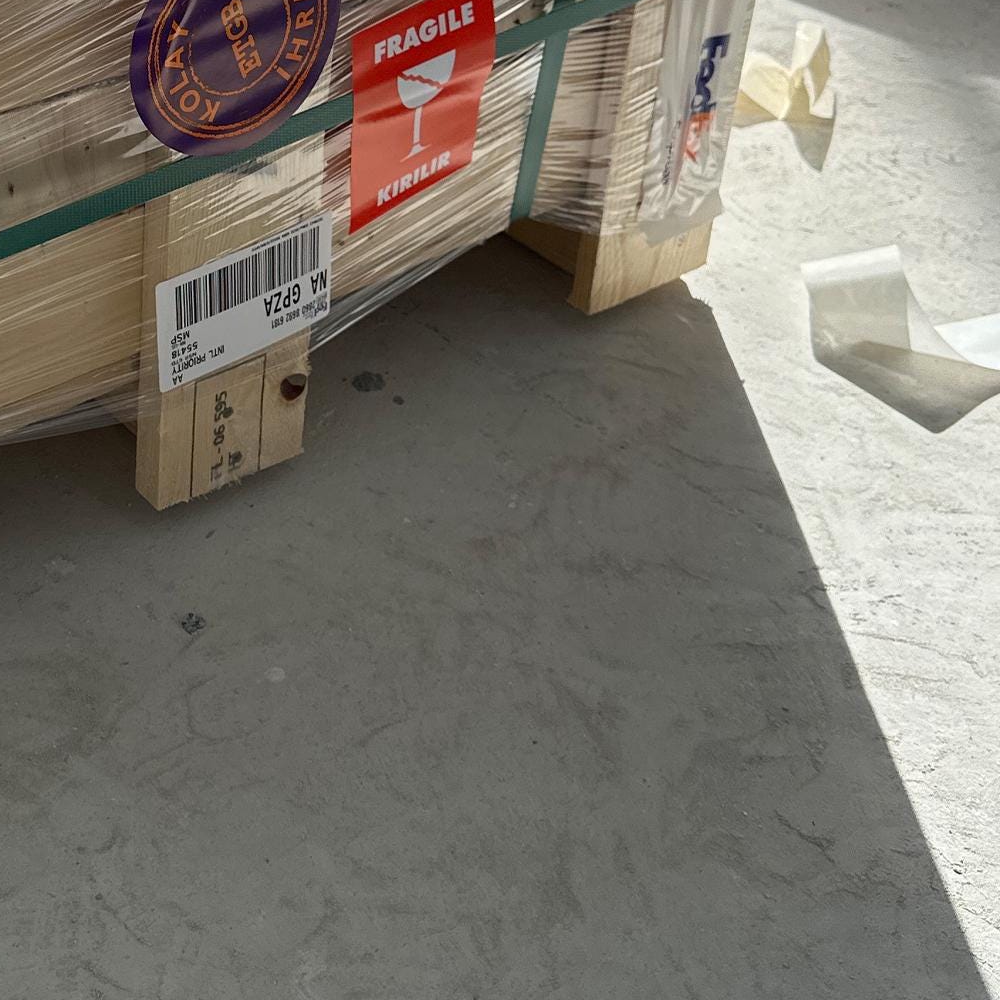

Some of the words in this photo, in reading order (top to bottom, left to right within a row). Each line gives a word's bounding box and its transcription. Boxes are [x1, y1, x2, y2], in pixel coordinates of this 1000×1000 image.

[373, 0, 476, 65] FRAGILE
[164, 19, 221, 123] KOLAY
[375, 150, 451, 207] KIRILIR
[310, 269, 328, 295] NA
[263, 283, 301, 317] GPZA
[170, 330, 190, 345] MSP
[171, 341, 199, 360] 55418
[171, 353, 207, 376] PRIORITY
[208, 344, 226, 359] INTL
